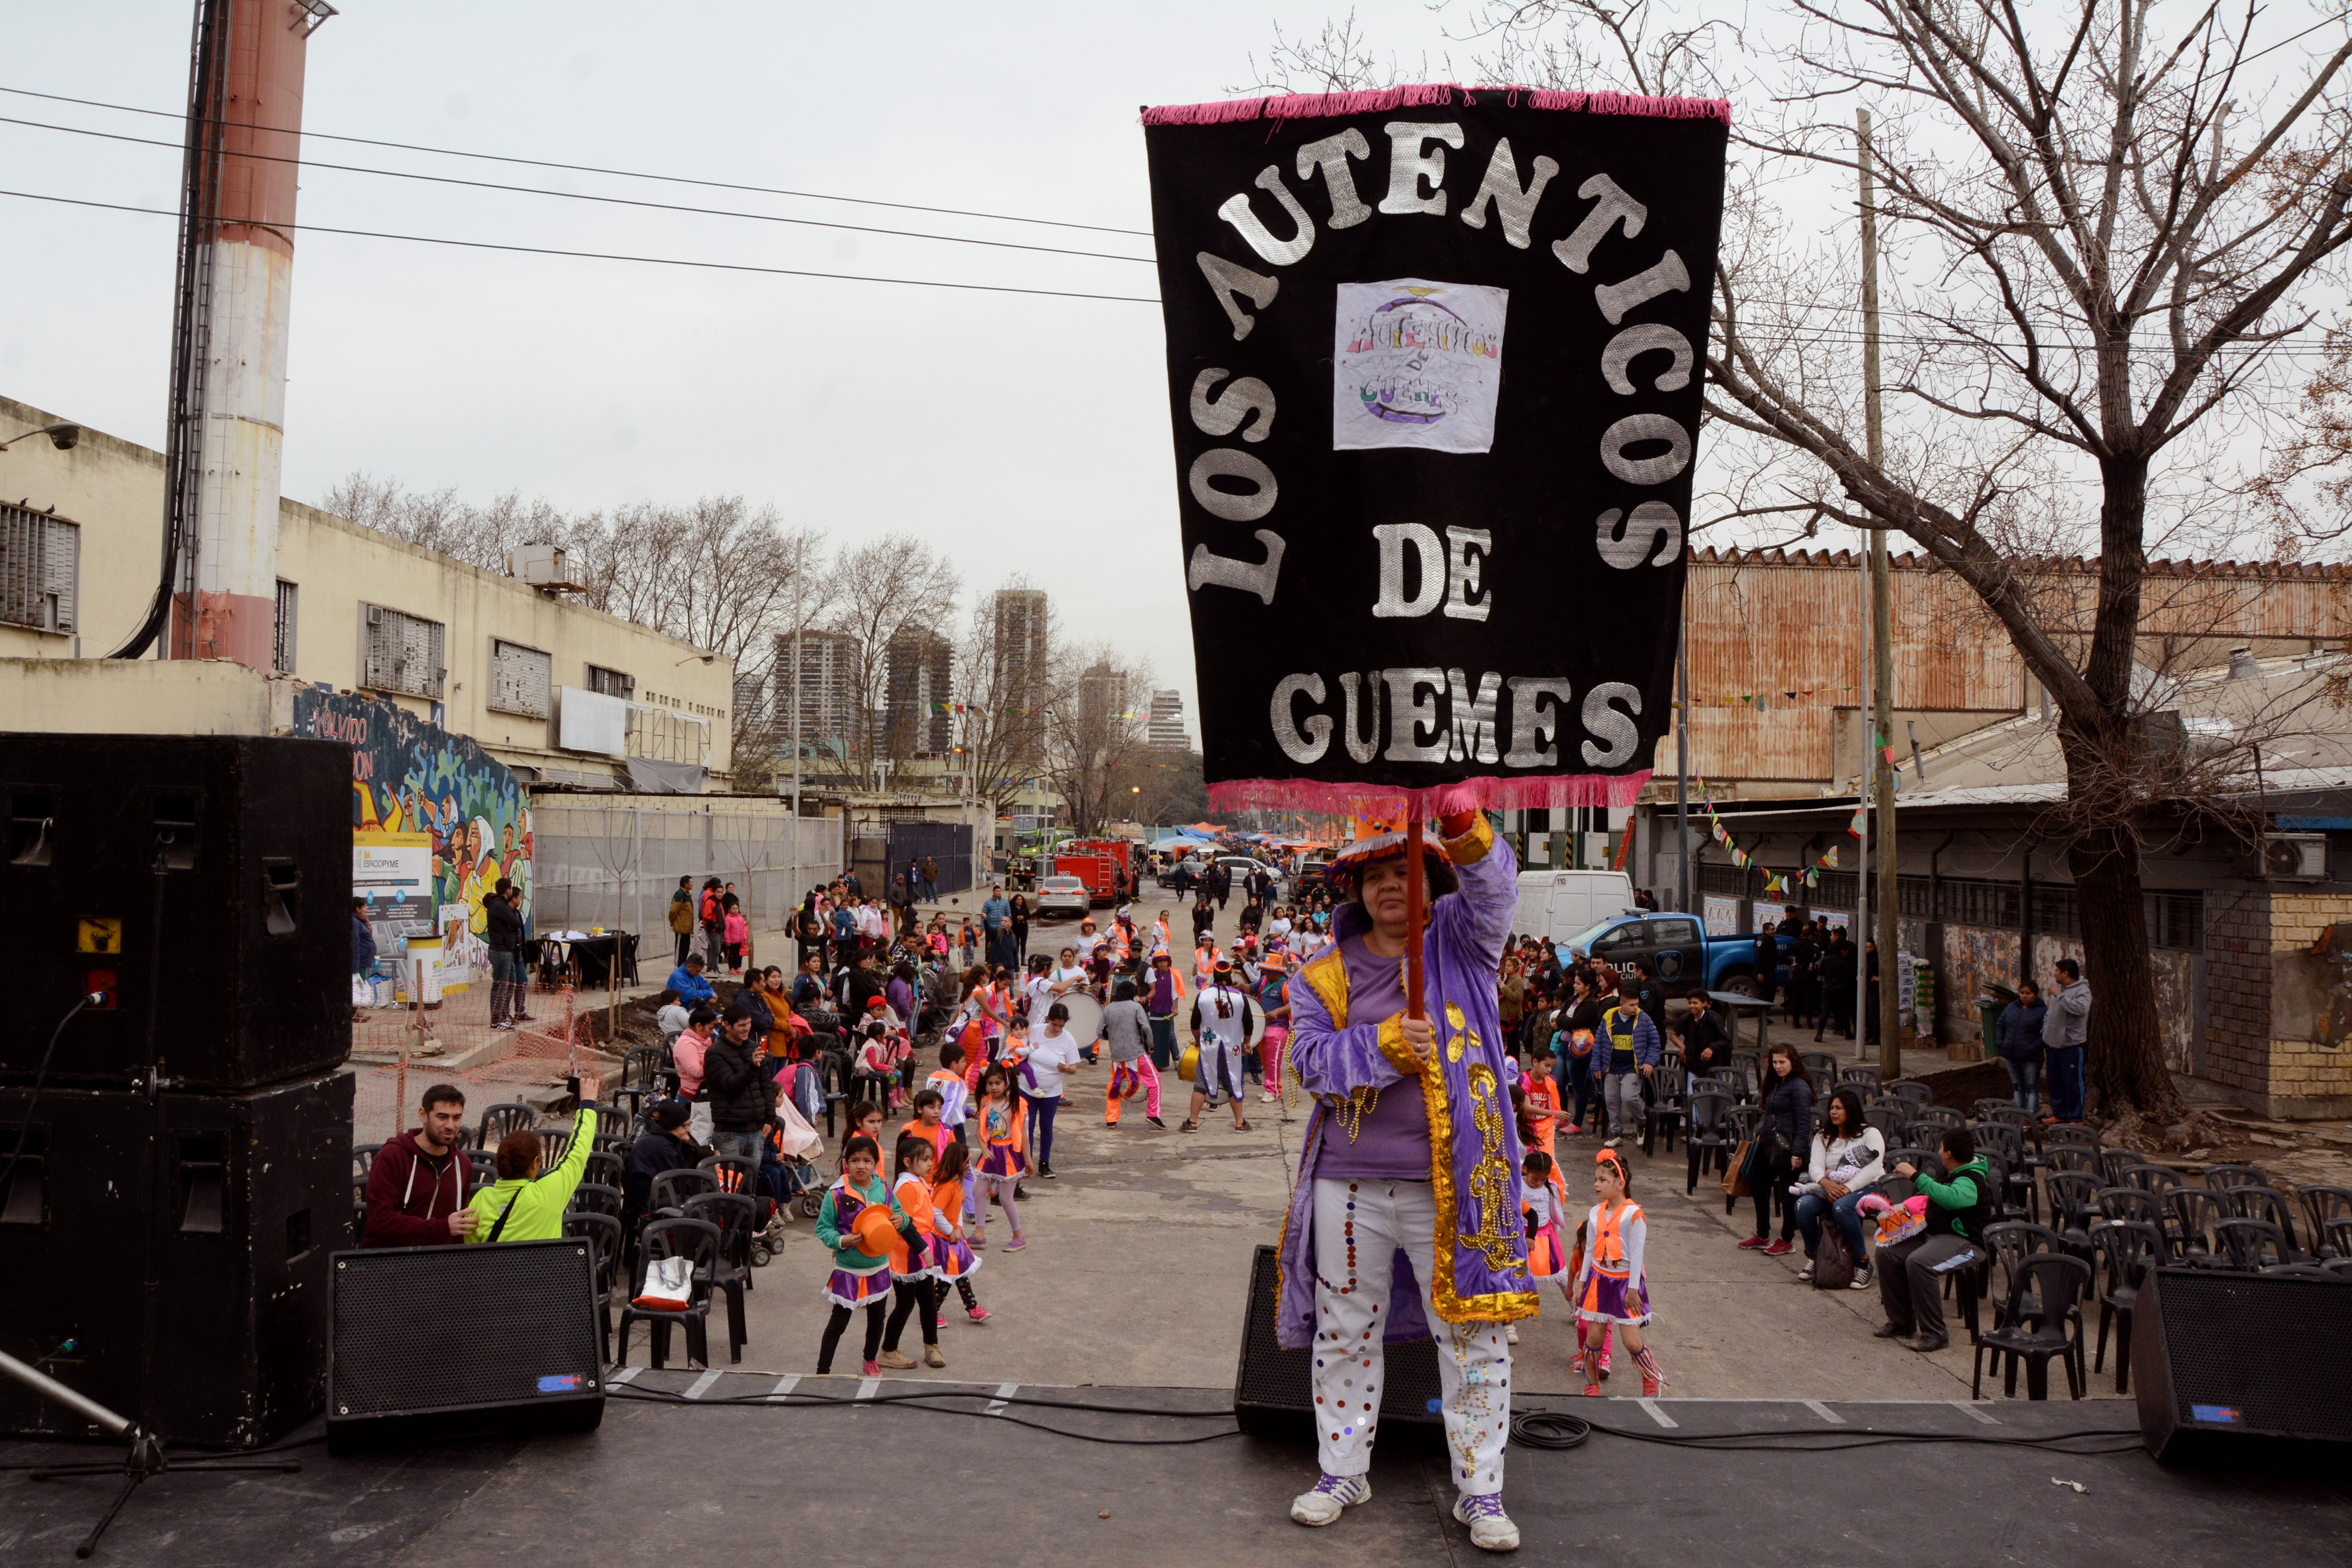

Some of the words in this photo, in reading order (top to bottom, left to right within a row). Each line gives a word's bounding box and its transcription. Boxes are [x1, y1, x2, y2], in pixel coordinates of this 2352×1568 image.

[1196, 121, 1695, 570] AUTENTICOS
[1346, 312, 1499, 359] AUTENTICOS
[1406, 351, 1430, 372] DE
[1360, 375, 1459, 415] GUEMES
[1188, 368, 1287, 605] LOS
[1372, 522, 1492, 622] DE
[323, 709, 367, 744] OLVIDO
[433, 708, 442, 730] 4
[1271, 667, 1643, 769] GUEMES
